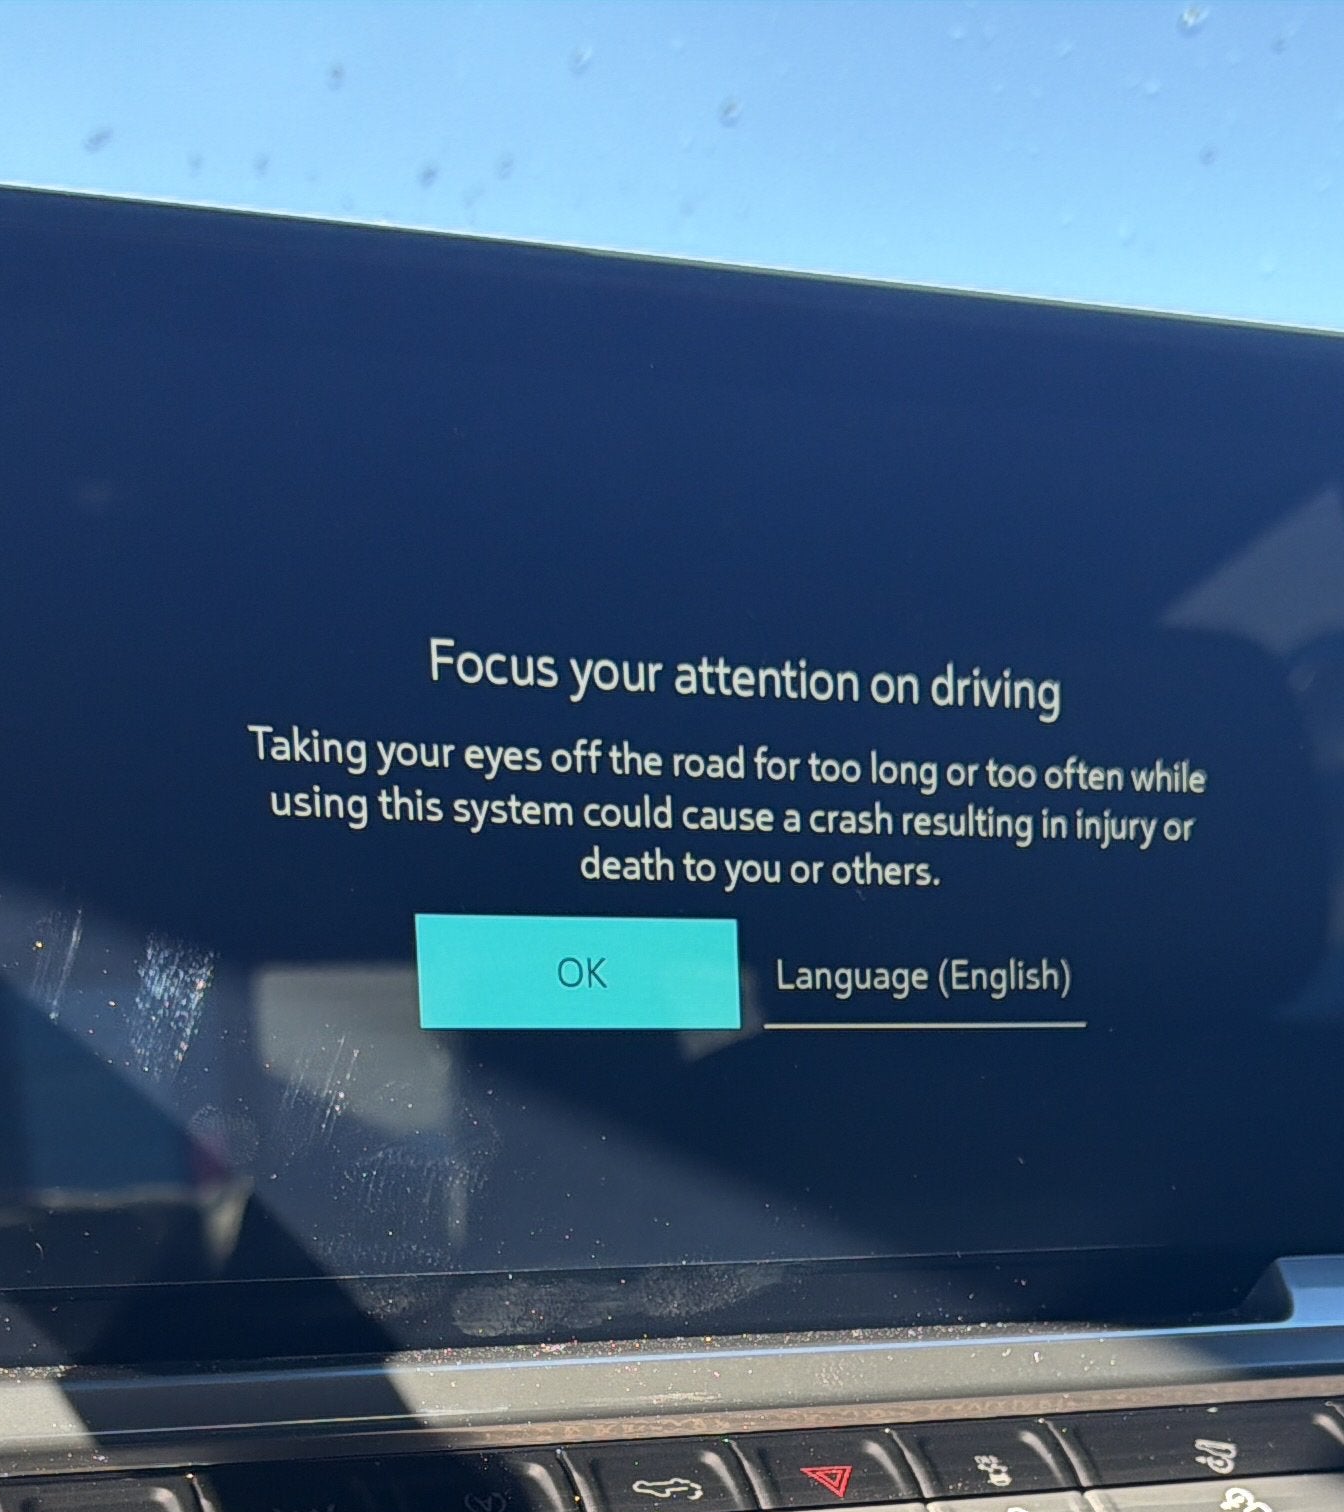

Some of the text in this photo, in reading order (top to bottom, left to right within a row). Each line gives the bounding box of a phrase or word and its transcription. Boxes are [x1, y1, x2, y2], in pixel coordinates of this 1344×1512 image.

[429, 636, 1061, 724] Focus your attention on driving
[247, 724, 1207, 796] Taking your eyes off the road for too long or too often while
[270, 784, 1195, 850] using this system could cause a crash resulting in injury or
[580, 844, 941, 893] death to you or others.
[557, 957, 608, 989] OK
[776, 957, 1071, 1000] Language (English)
